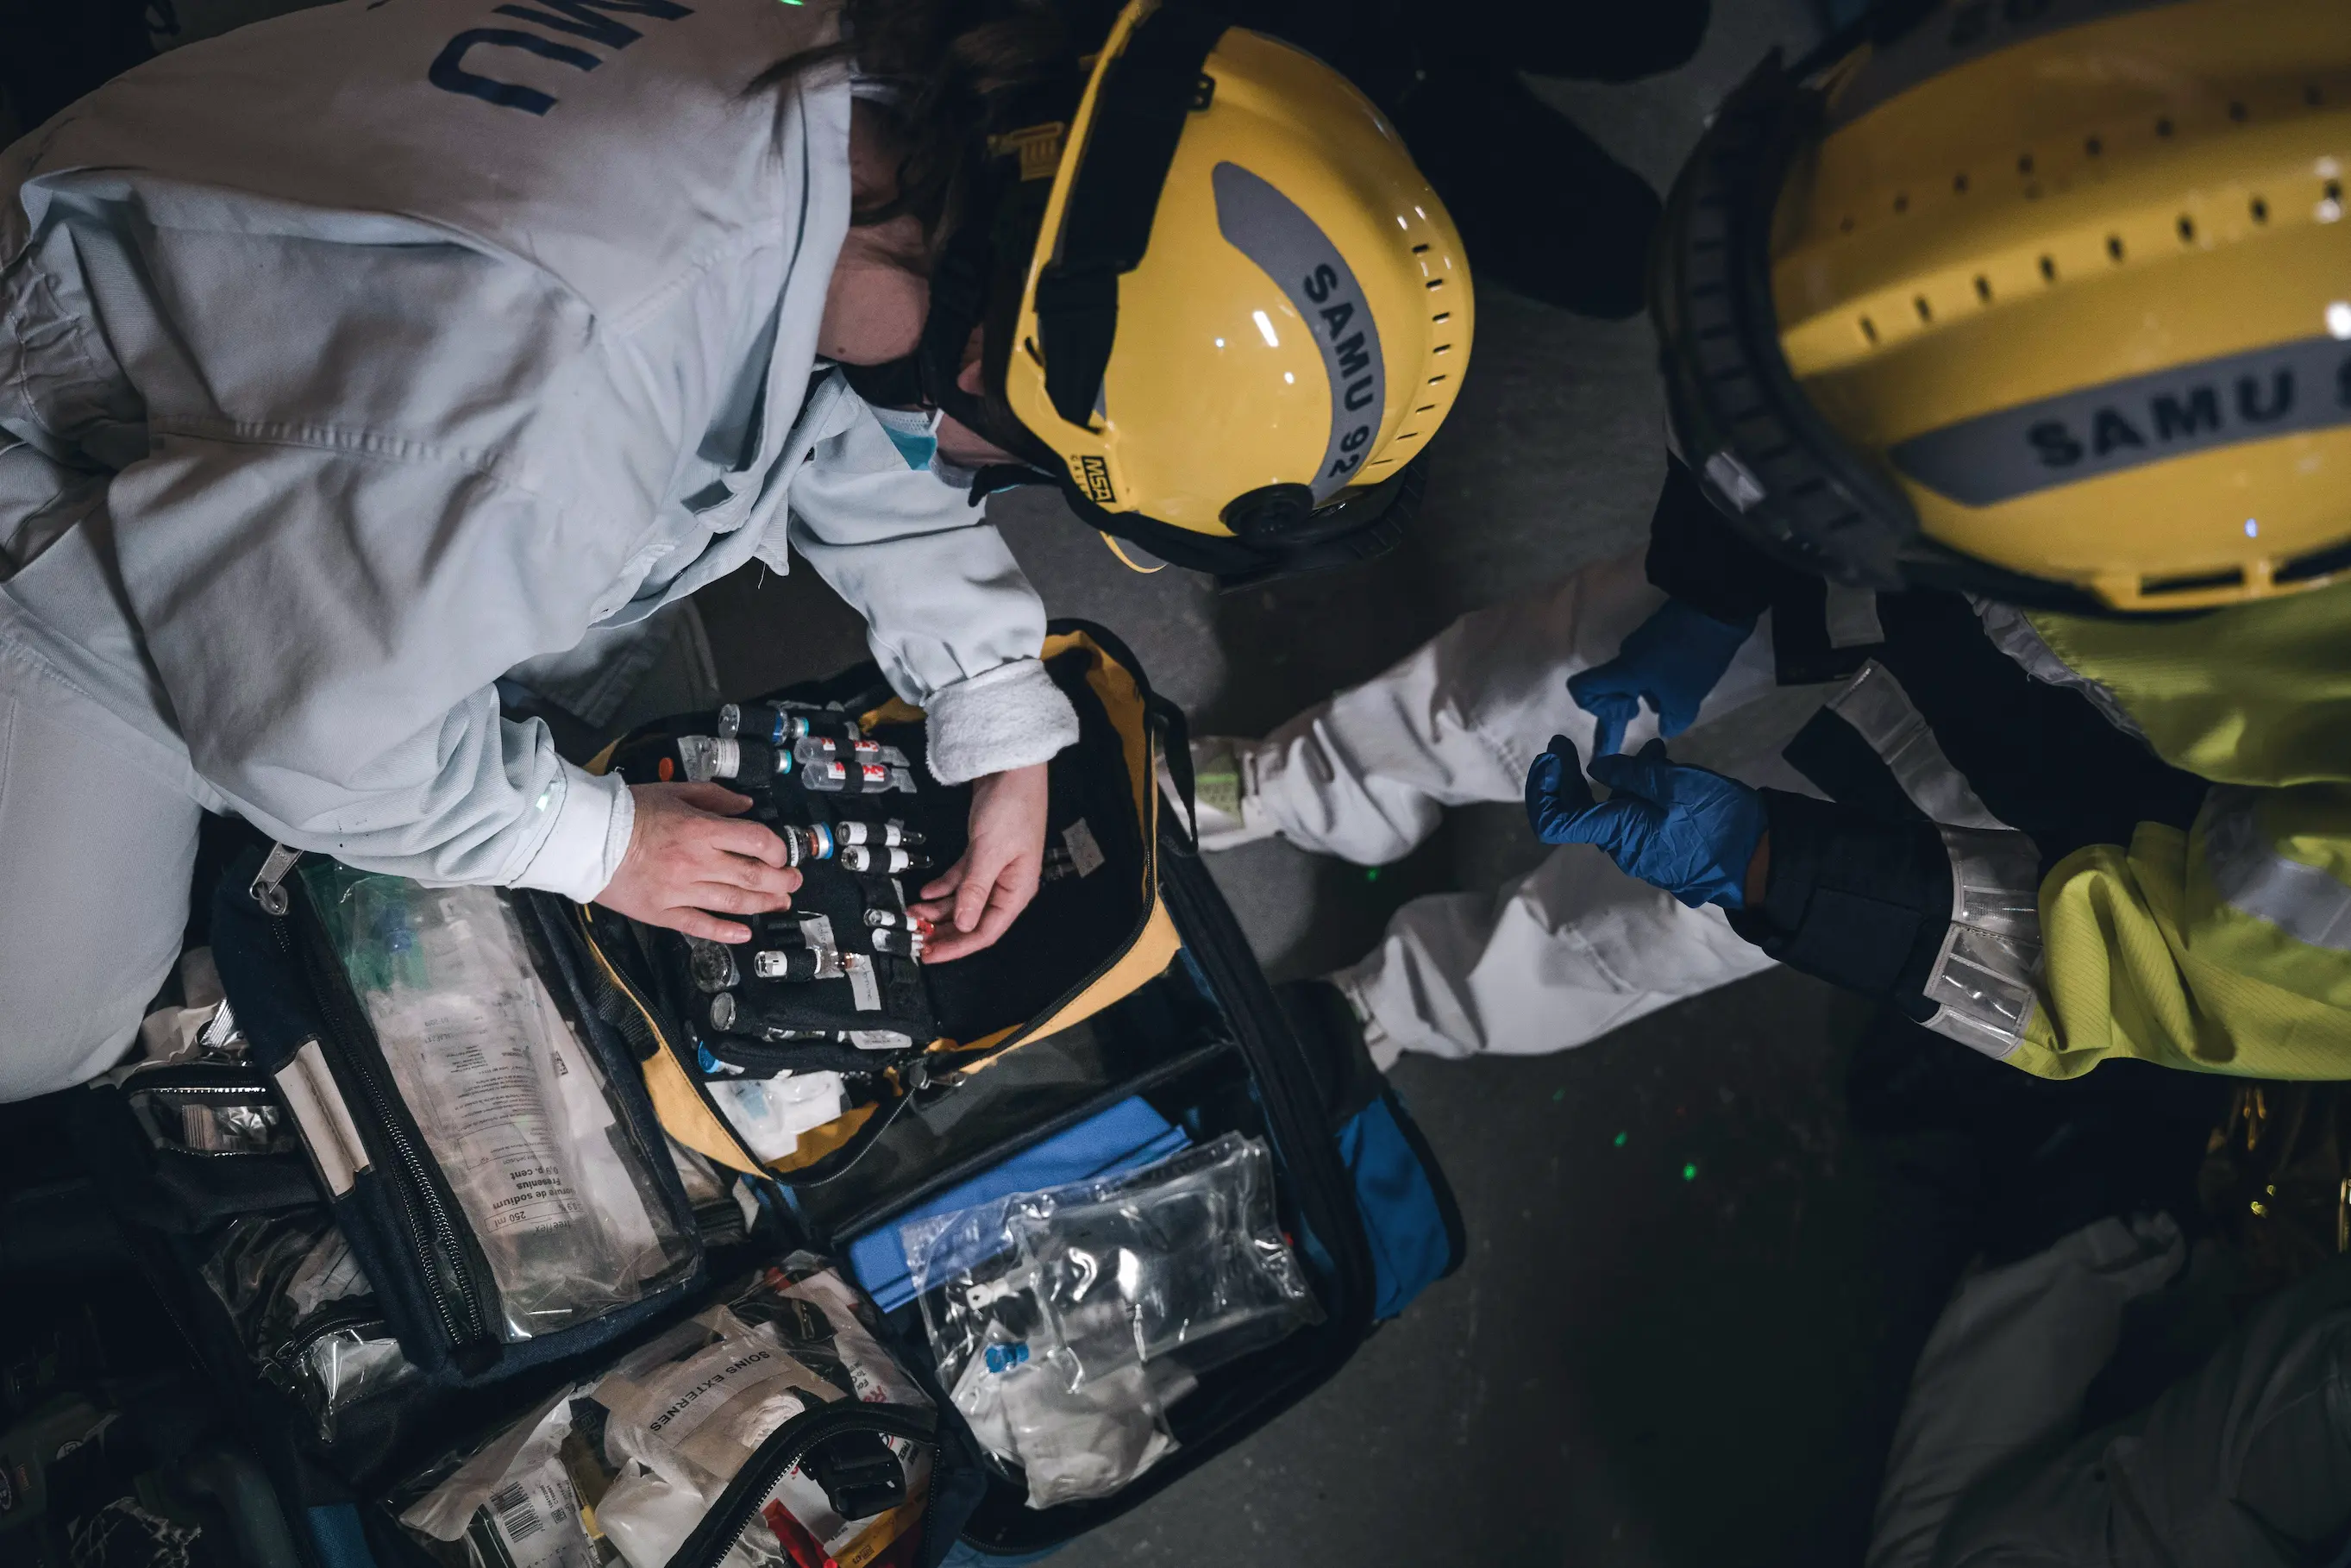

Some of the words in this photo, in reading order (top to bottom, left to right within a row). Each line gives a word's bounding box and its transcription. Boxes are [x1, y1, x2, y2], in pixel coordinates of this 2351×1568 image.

[1303, 263, 1375, 412] SAMU
[2027, 369, 2296, 468] SAMU
[1328, 425, 1370, 479] 92
[1083, 457, 1114, 502] MSA
[510, 1170, 533, 1181] cent
[516, 1177, 561, 1189] Fresenius
[492, 1193, 533, 1209] sodium
[494, 1218, 506, 1227] ml
[509, 1211, 526, 1222] 250
[725, 1351, 770, 1374] SOINS
[650, 1374, 724, 1432] EXTERNES
[898, 1441, 911, 1461] FREE
